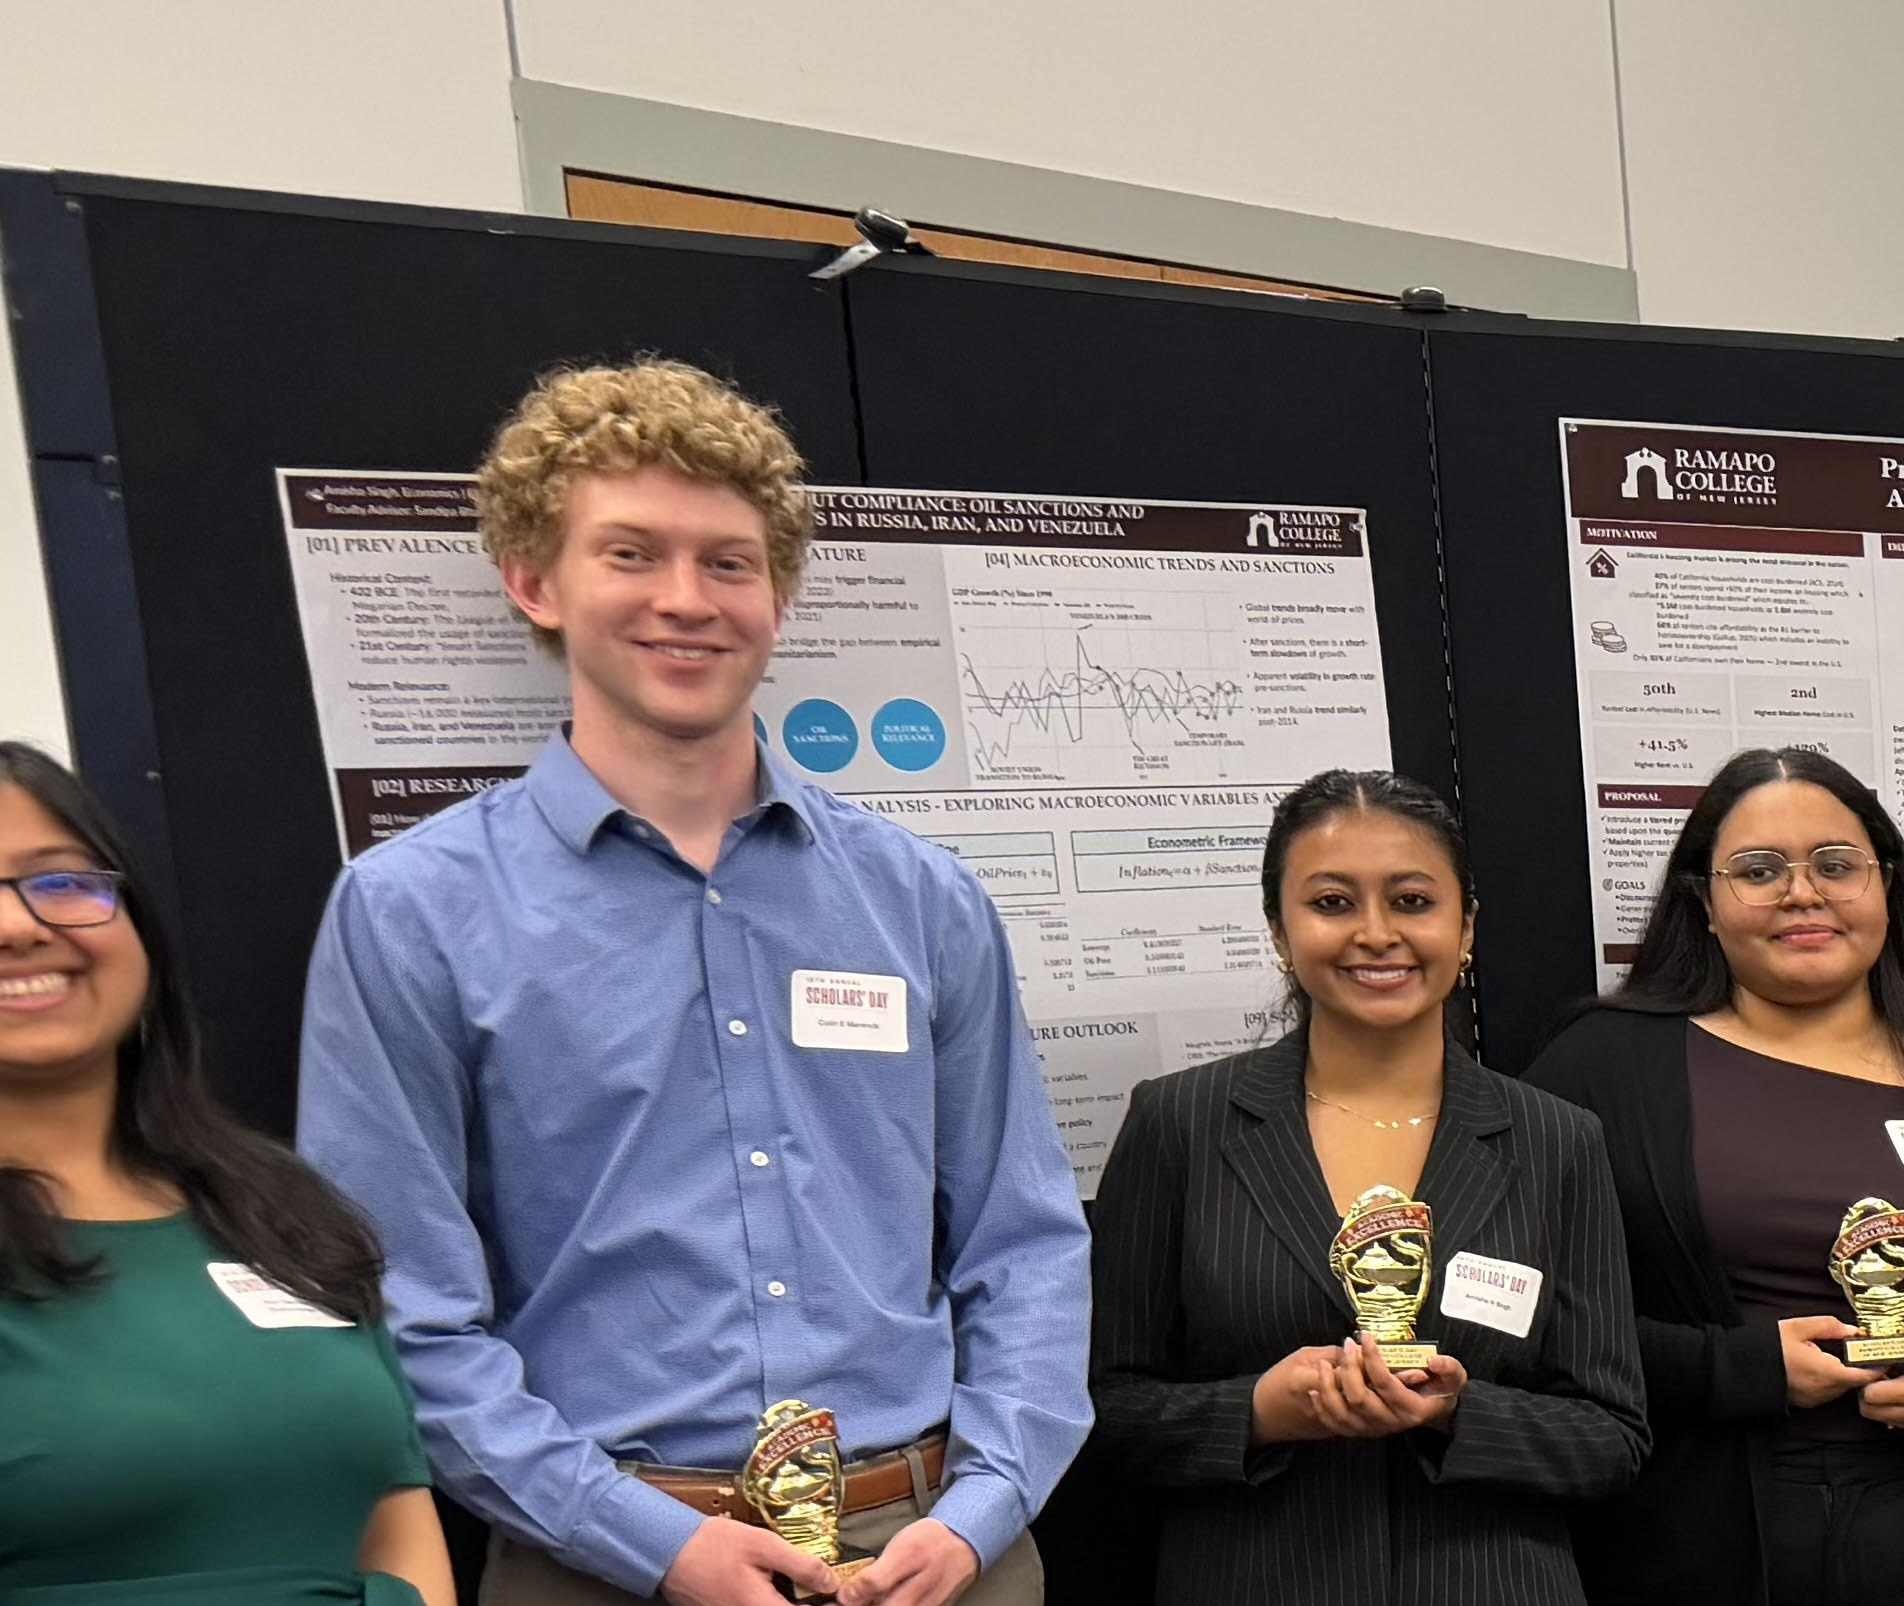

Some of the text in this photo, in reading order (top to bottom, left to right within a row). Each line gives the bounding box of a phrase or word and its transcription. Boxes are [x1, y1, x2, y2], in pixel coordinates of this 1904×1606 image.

[1674, 449, 1776, 473] RAMAPO
[1675, 471, 1777, 495] COLLEGE
[843, 494, 967, 514] COMPLIANCE:
[969, 499, 1000, 514] OIL
[1003, 499, 1103, 518] SANCTIONS
[1107, 505, 1145, 520] AND
[831, 512, 1126, 537] IN RUSSIA, IRAN, AND VENEZUELA
[1279, 512, 1342, 527] RAMAPO
[1279, 527, 1342, 542] COLLEGE
[1586, 527, 1658, 541] MOTIVATION
[306, 537, 477, 555] [01] PREVALENCE
[985, 552, 1336, 576] [04] MACROECONOMIC TRENDS AND SANCTIONS
[1642, 682, 1818, 700] 50th 2nd
[371, 778, 407, 798] [02]
[1604, 791, 1663, 802] PROPOSAL
[944, 798, 1036, 812] EXPLORING
[1039, 795, 1177, 811] MACROECONOMIC
[1181, 793, 1260, 807] VARIABLES
[1147, 834, 1267, 850] Econometric Framewo
[1614, 880, 1647, 891] GOALS
[805, 985, 889, 1009] SCHOLARS' DAY
[1063, 1021, 1139, 1039] OUTLOOK
